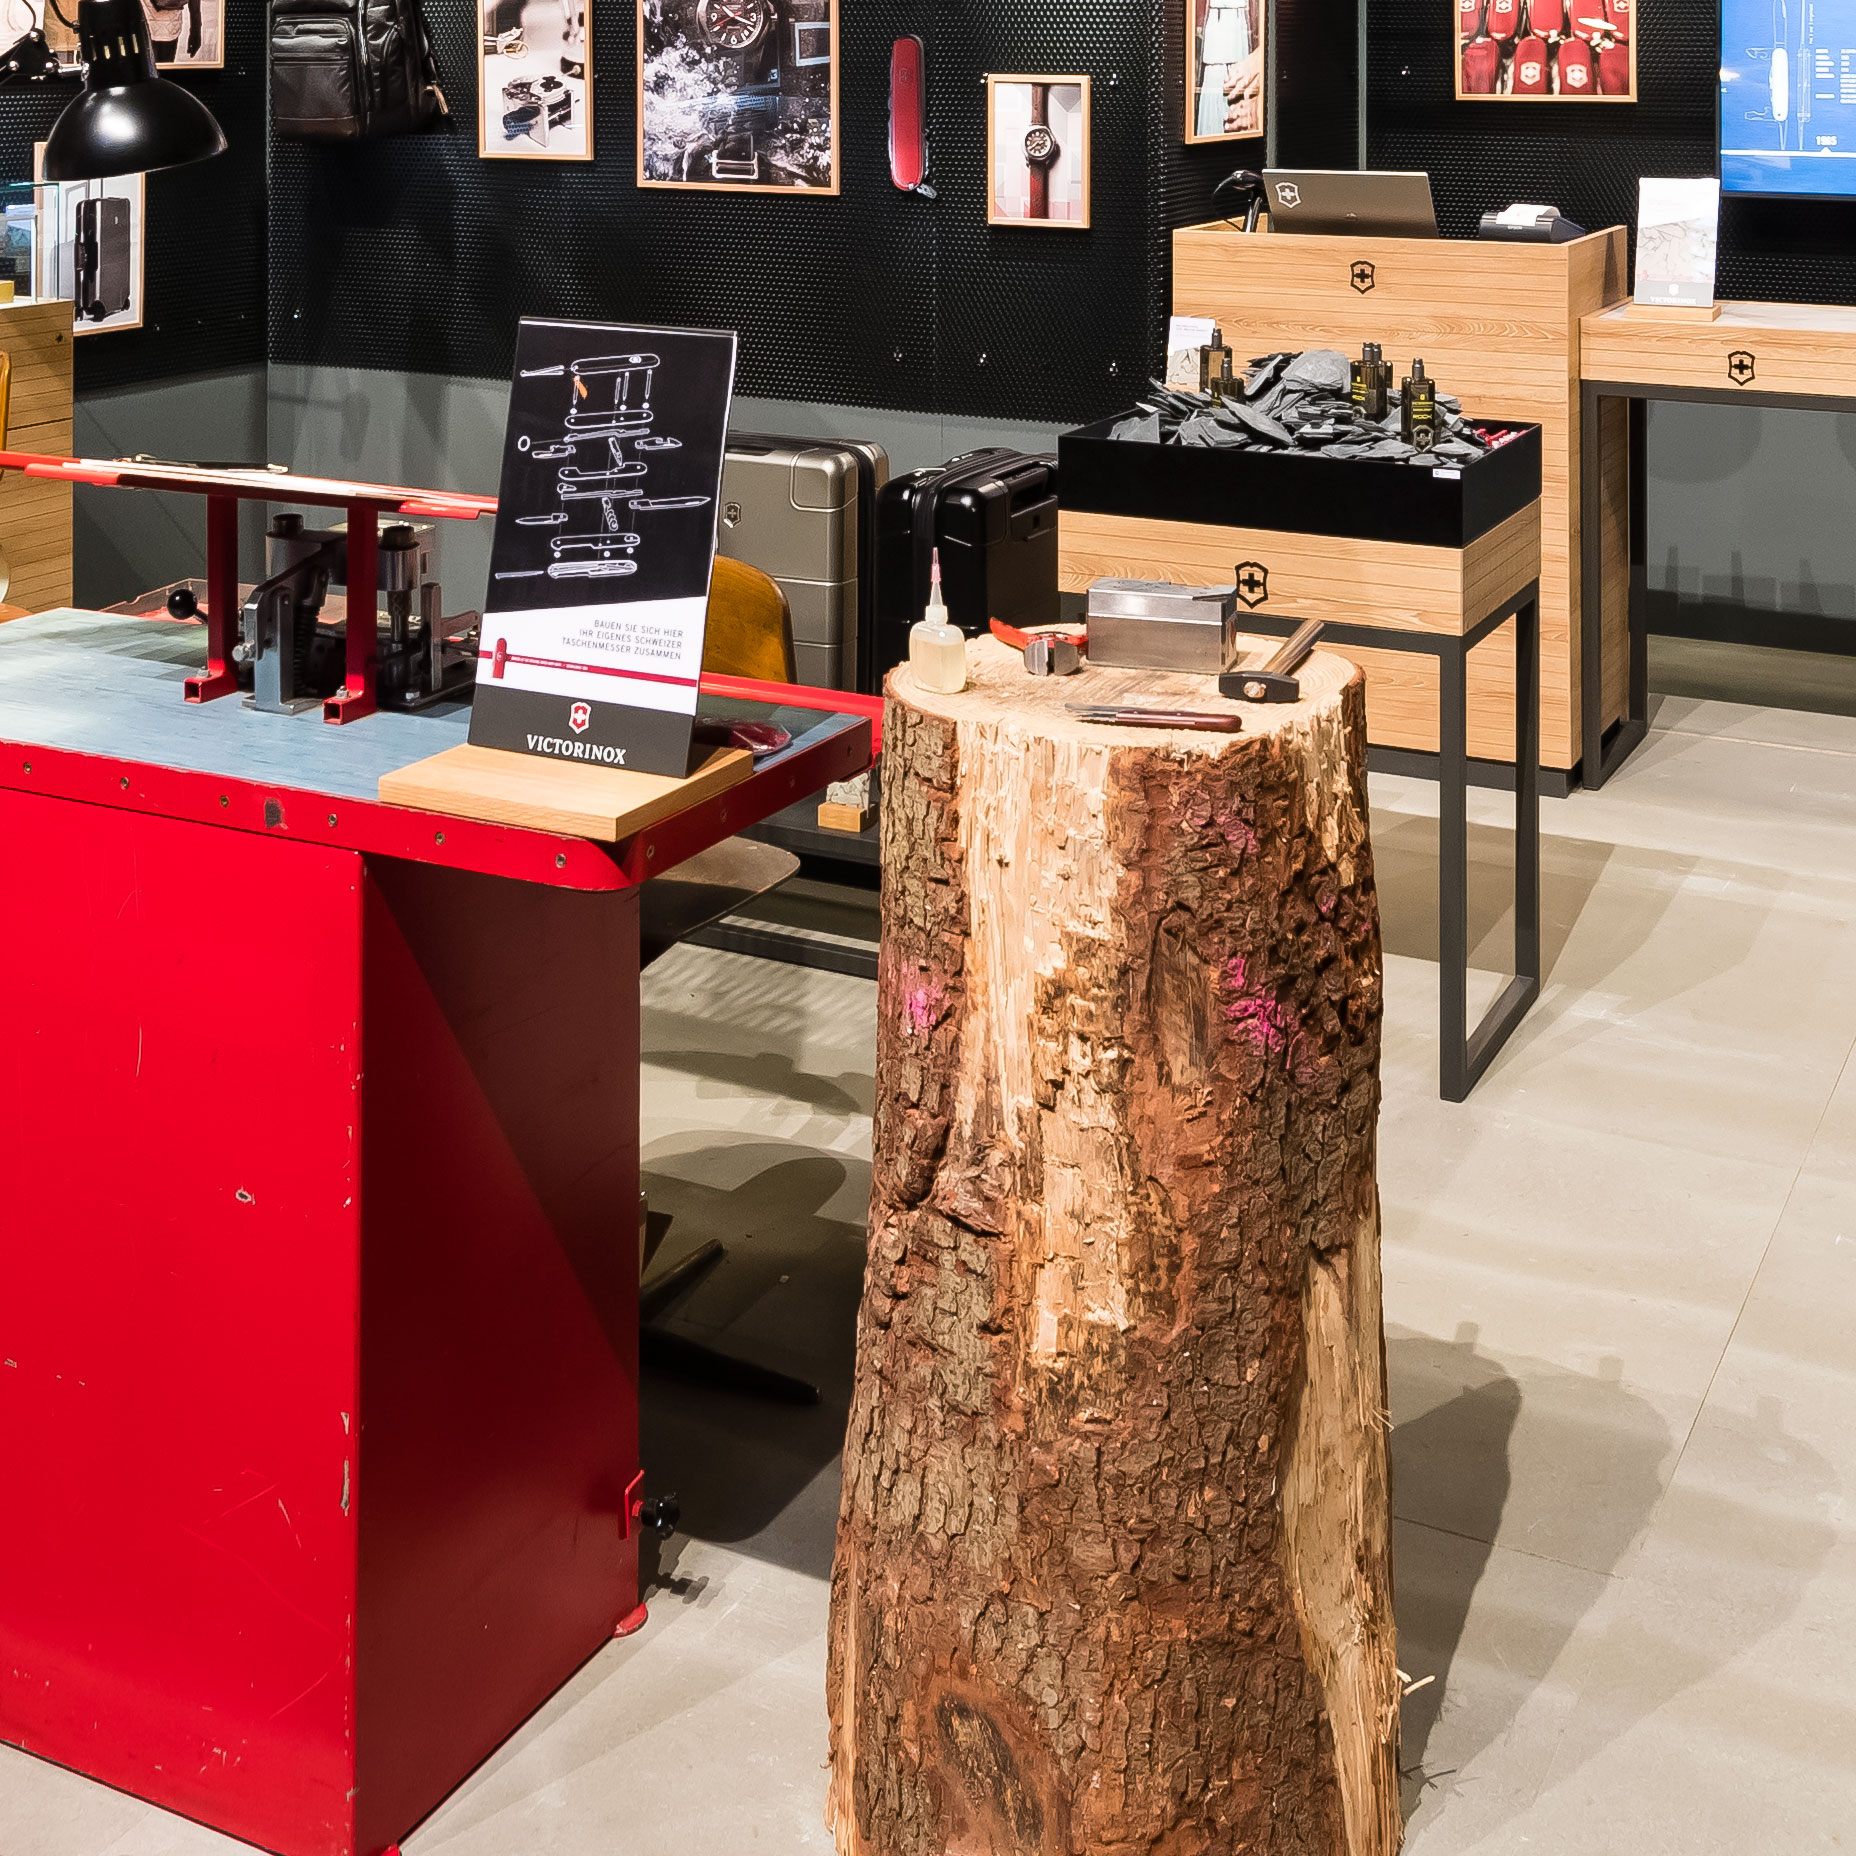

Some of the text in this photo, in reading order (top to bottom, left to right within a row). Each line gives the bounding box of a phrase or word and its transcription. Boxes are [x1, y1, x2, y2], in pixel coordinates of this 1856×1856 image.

[579, 628, 682, 649] IHR EIGENES SCHWEIZER
[594, 619, 683, 638] BAUEN SIE SICH HIER
[562, 637, 681, 660] TASCHENMESSER ZUSAMMEN
[526, 734, 627, 765] VICTORINOX
